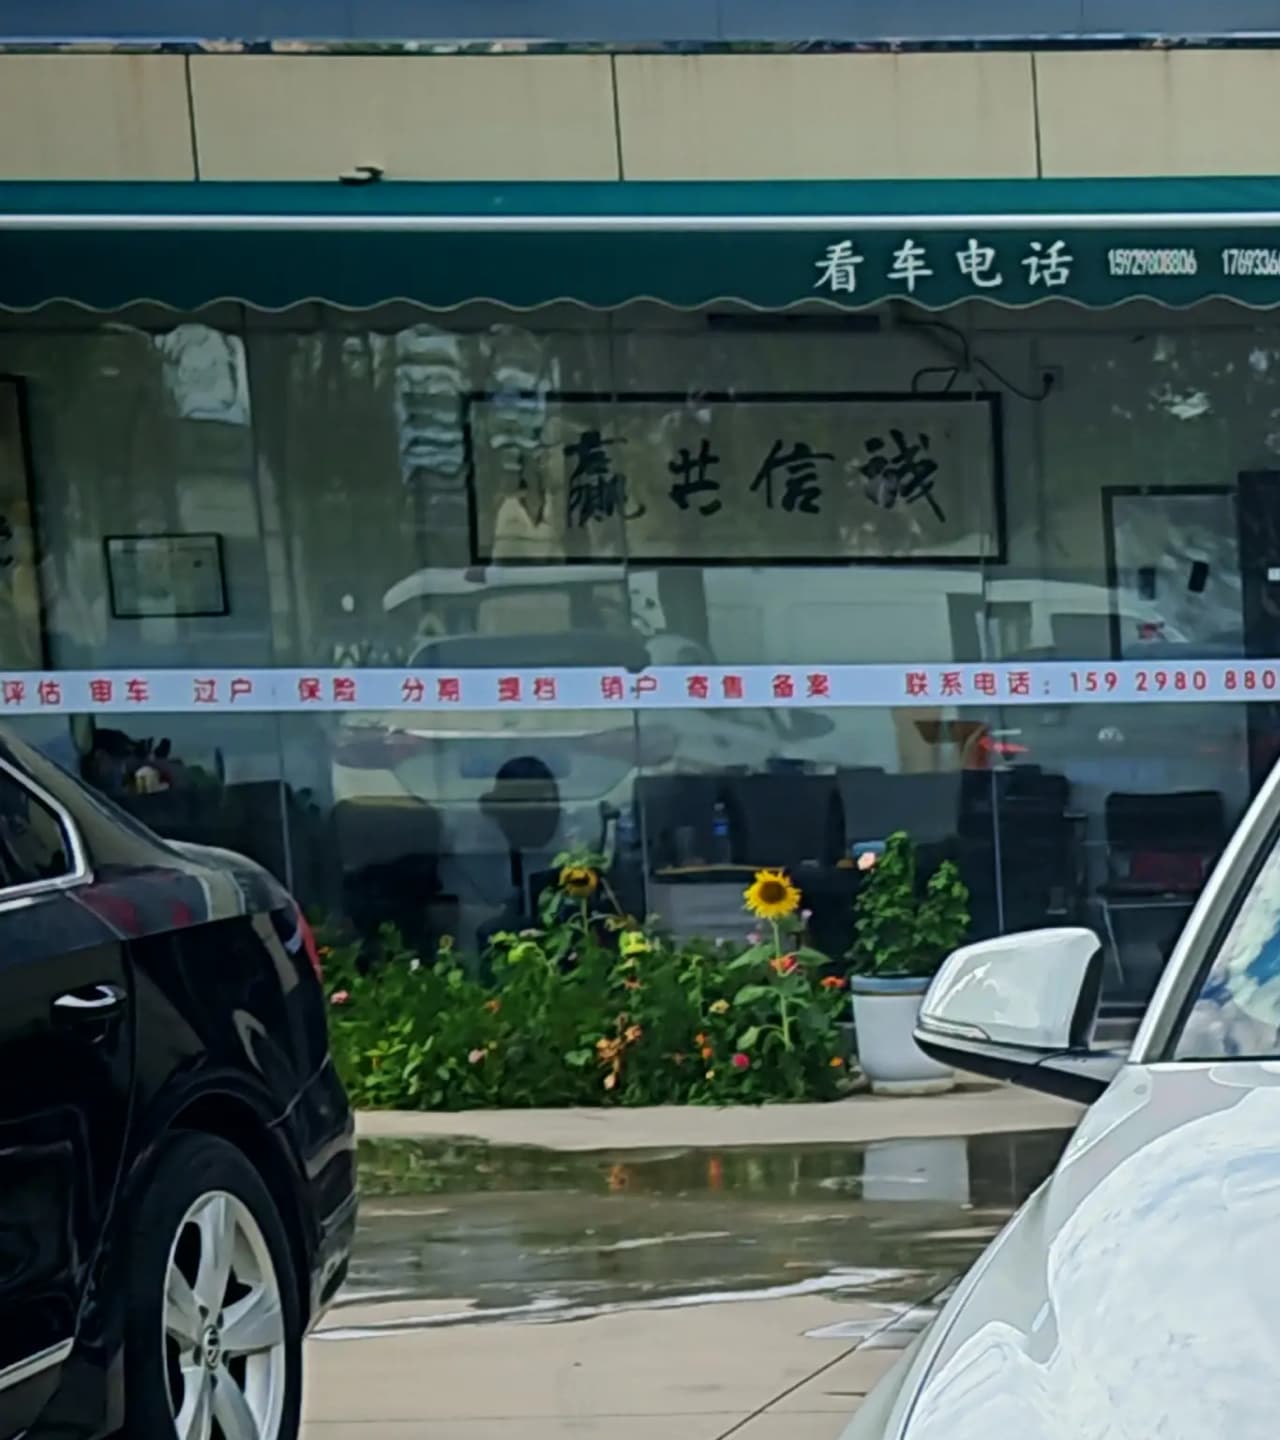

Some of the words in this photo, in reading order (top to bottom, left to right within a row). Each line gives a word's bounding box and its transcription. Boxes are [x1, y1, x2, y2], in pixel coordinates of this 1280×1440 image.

[814, 238, 1074, 292] 看车电话
[193, 678, 253, 703] 过户
[298, 677, 356, 703] 保险
[773, 673, 830, 698] 备案
[1070, 671, 1118, 693] 159
[1135, 670, 1208, 691] 2980
